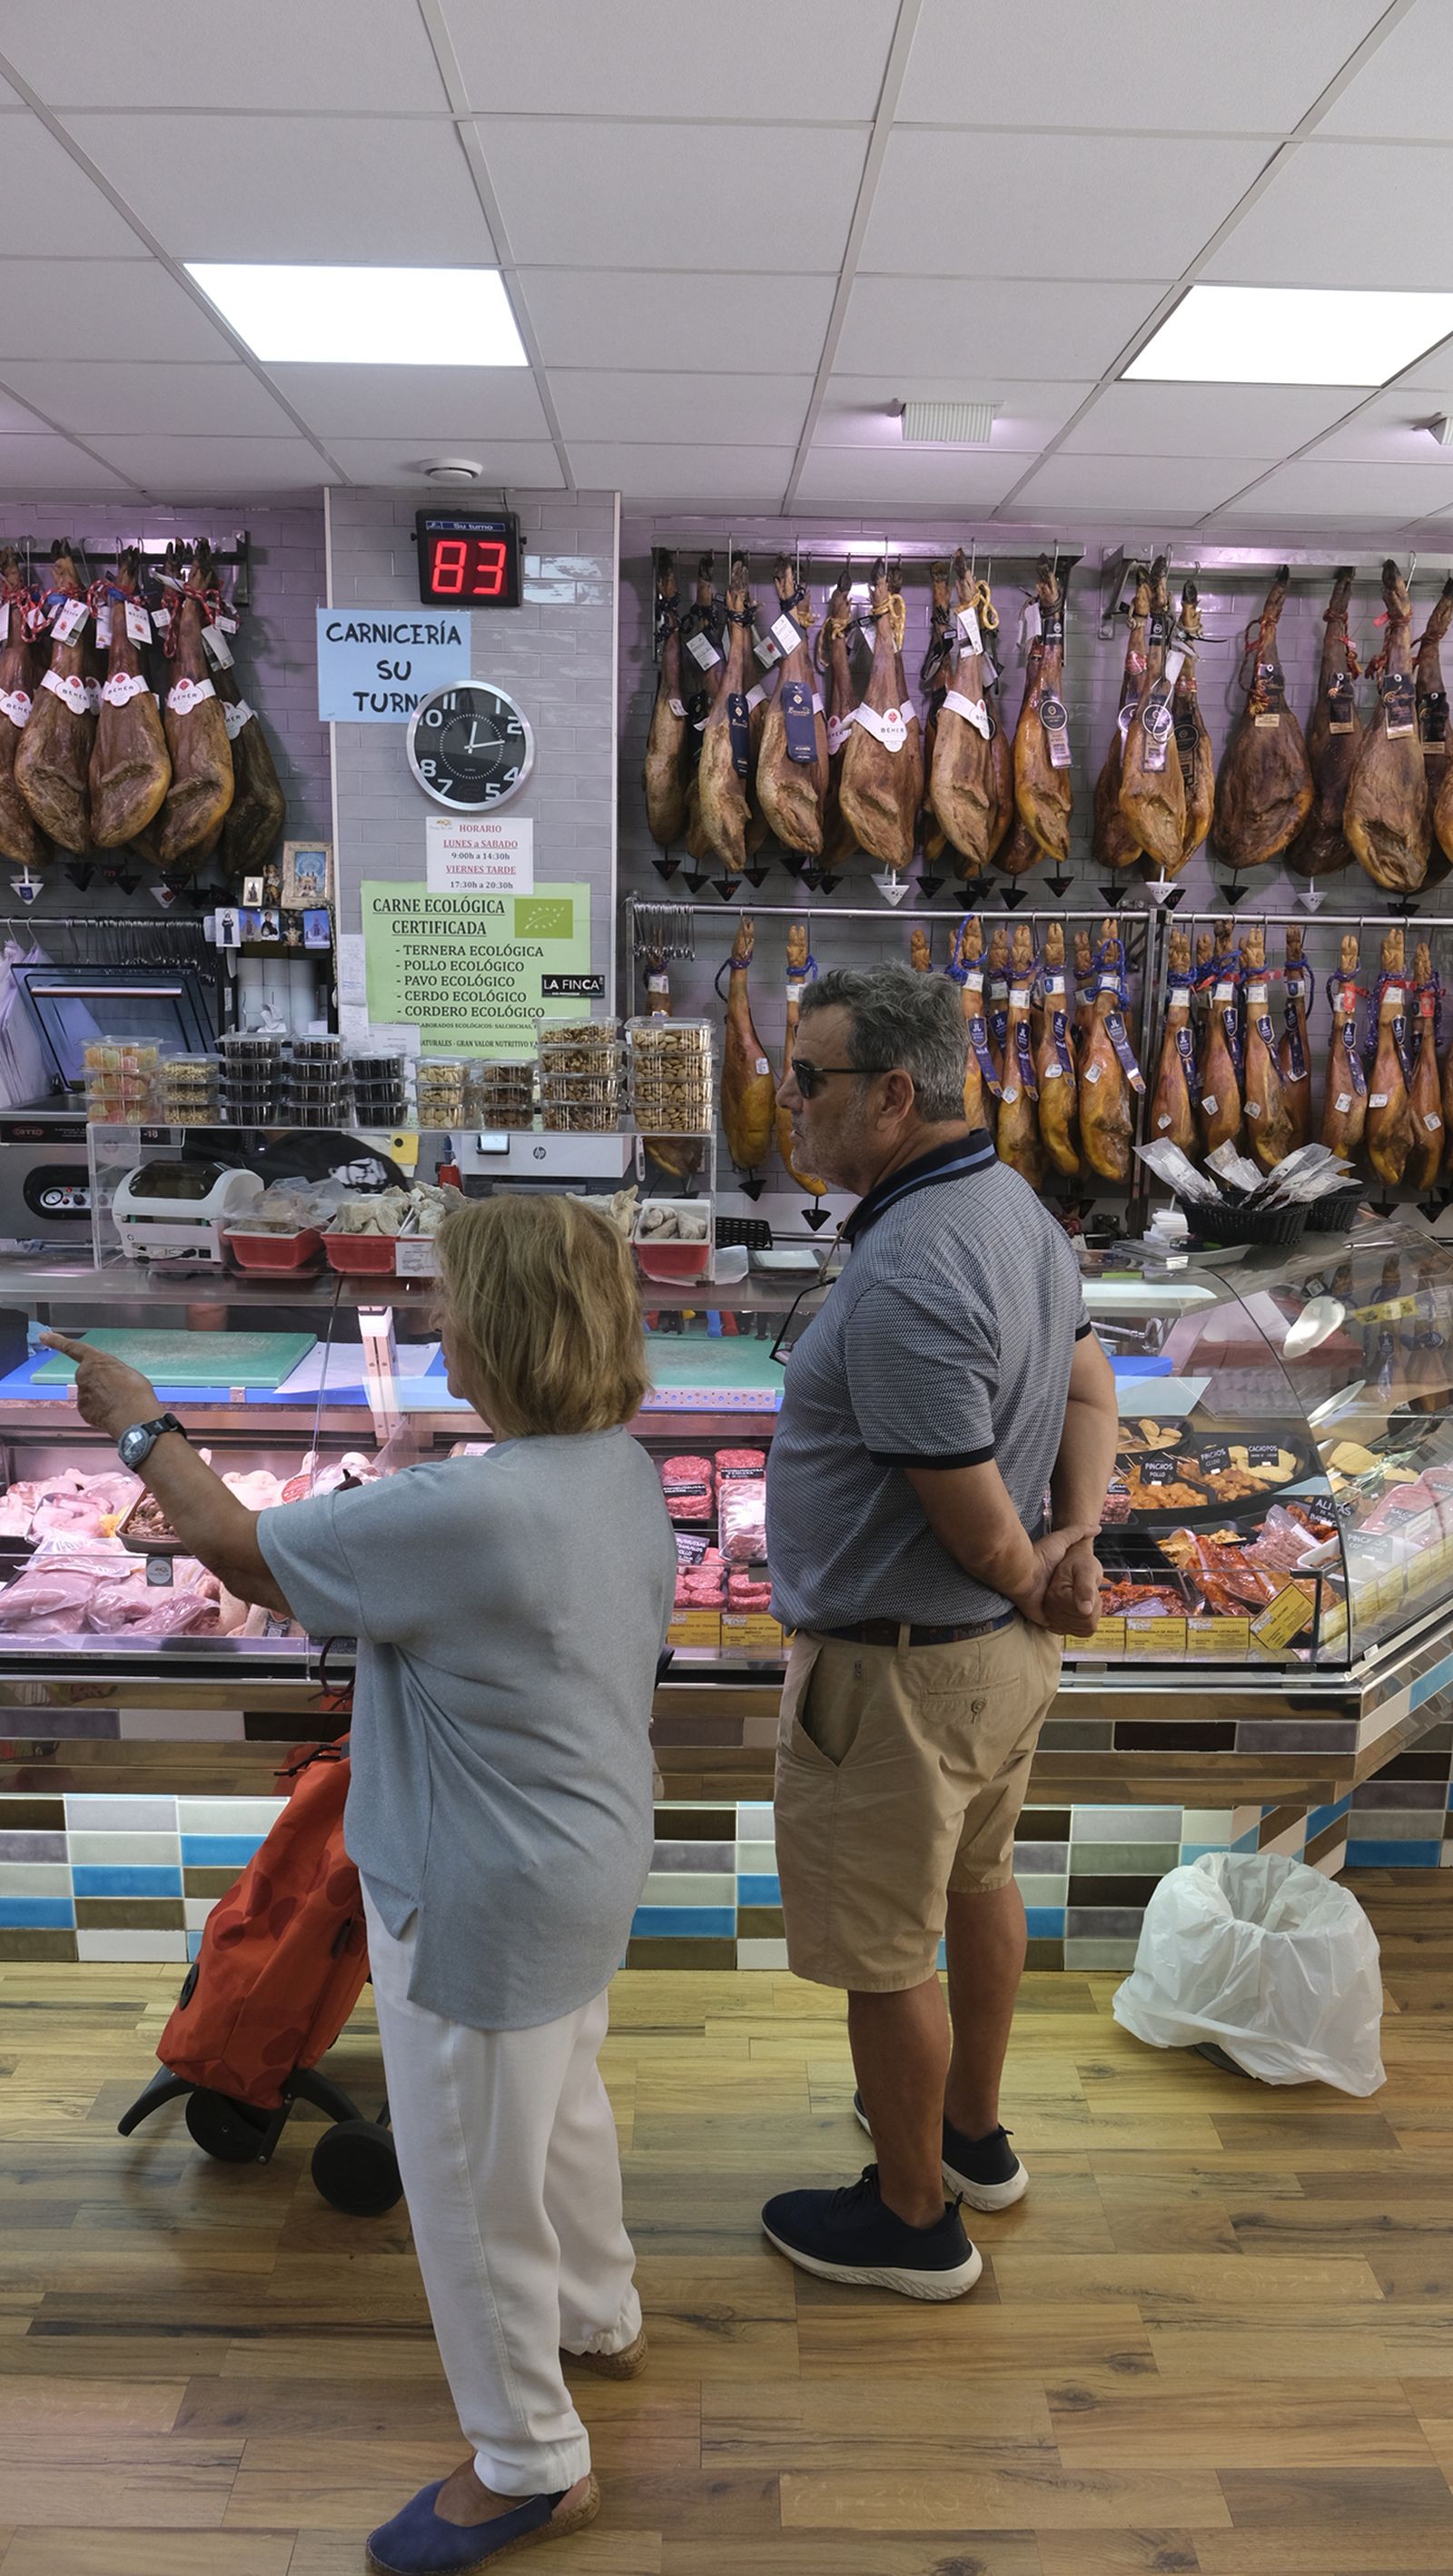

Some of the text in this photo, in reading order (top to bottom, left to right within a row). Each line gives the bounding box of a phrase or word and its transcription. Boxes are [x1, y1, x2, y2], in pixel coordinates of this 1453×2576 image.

[431, 540, 507, 594] 83
[325, 619, 461, 646] CARNICERÍA
[376, 659, 412, 681] SU
[6, 703, 31, 714] BEHE
[352, 691, 429, 713] TURN
[507, 716, 523, 735] 2
[420, 759, 436, 777] 8
[459, 824, 502, 833] HORARIO
[443, 839, 472, 849] LUNES
[480, 839, 519, 850] SABADO
[482, 852, 510, 861] 14:30h
[445, 864, 517, 875] VIERNES TARDE
[450, 881, 478, 889] 17:30h
[485, 881, 514, 890] 20:30h
[372, 895, 505, 914] CARNE ECOLÓGICA
[391, 919, 487, 936] CERTIFICADA
[402, 944, 467, 956] TERNERA
[470, 943, 544, 957] ECOLÓGICA
[404, 960, 447, 972] POLLO
[450, 958, 525, 972] ECOLÓGICO
[404, 975, 438, 986] PAVO
[440, 973, 516, 987] ECOLÓGICO
[543, 979, 559, 990] LA
[562, 979, 599, 991] FINCA
[404, 991, 450, 1002] CERDO
[452, 989, 527, 1003] ECOLÓGICO
[404, 1005, 468, 1017] CORDERO
[470, 1004, 546, 1018] ECOLÓGICO
[1315, 1498, 1352, 1516] ALIAS
